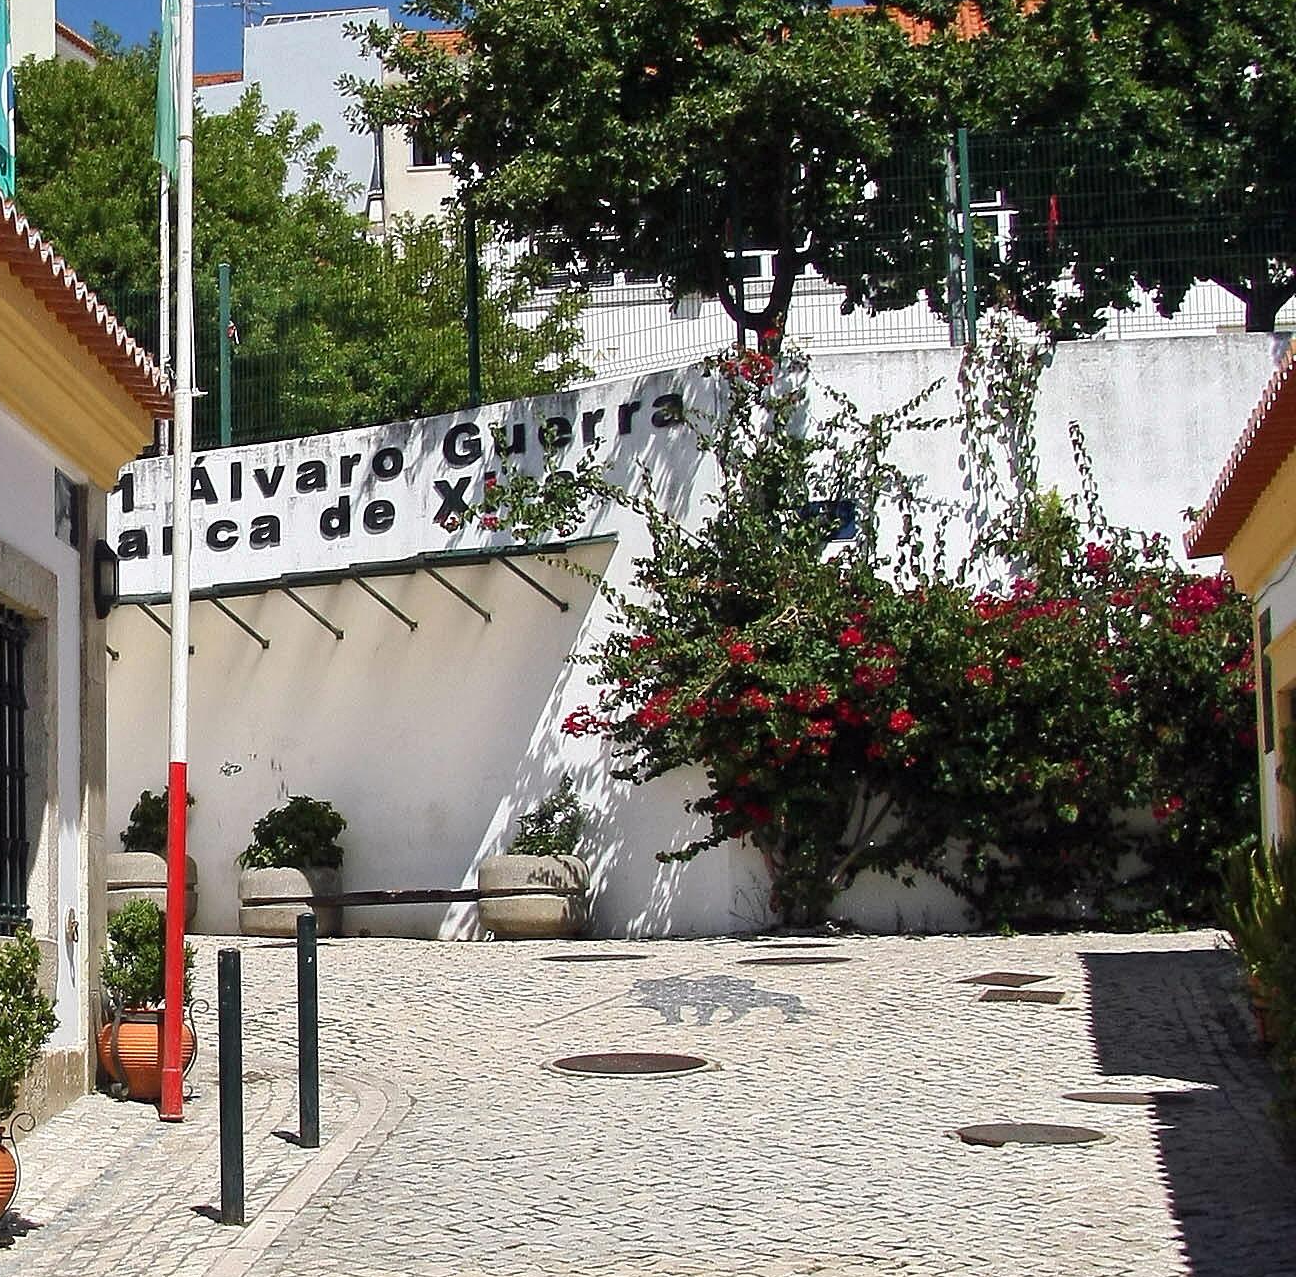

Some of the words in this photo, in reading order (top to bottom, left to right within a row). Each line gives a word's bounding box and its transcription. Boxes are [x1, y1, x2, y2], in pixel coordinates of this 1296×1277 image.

[190, 446, 404, 506] Álvaro
[442, 393, 684, 469] Guerra
[320, 495, 396, 542] de
